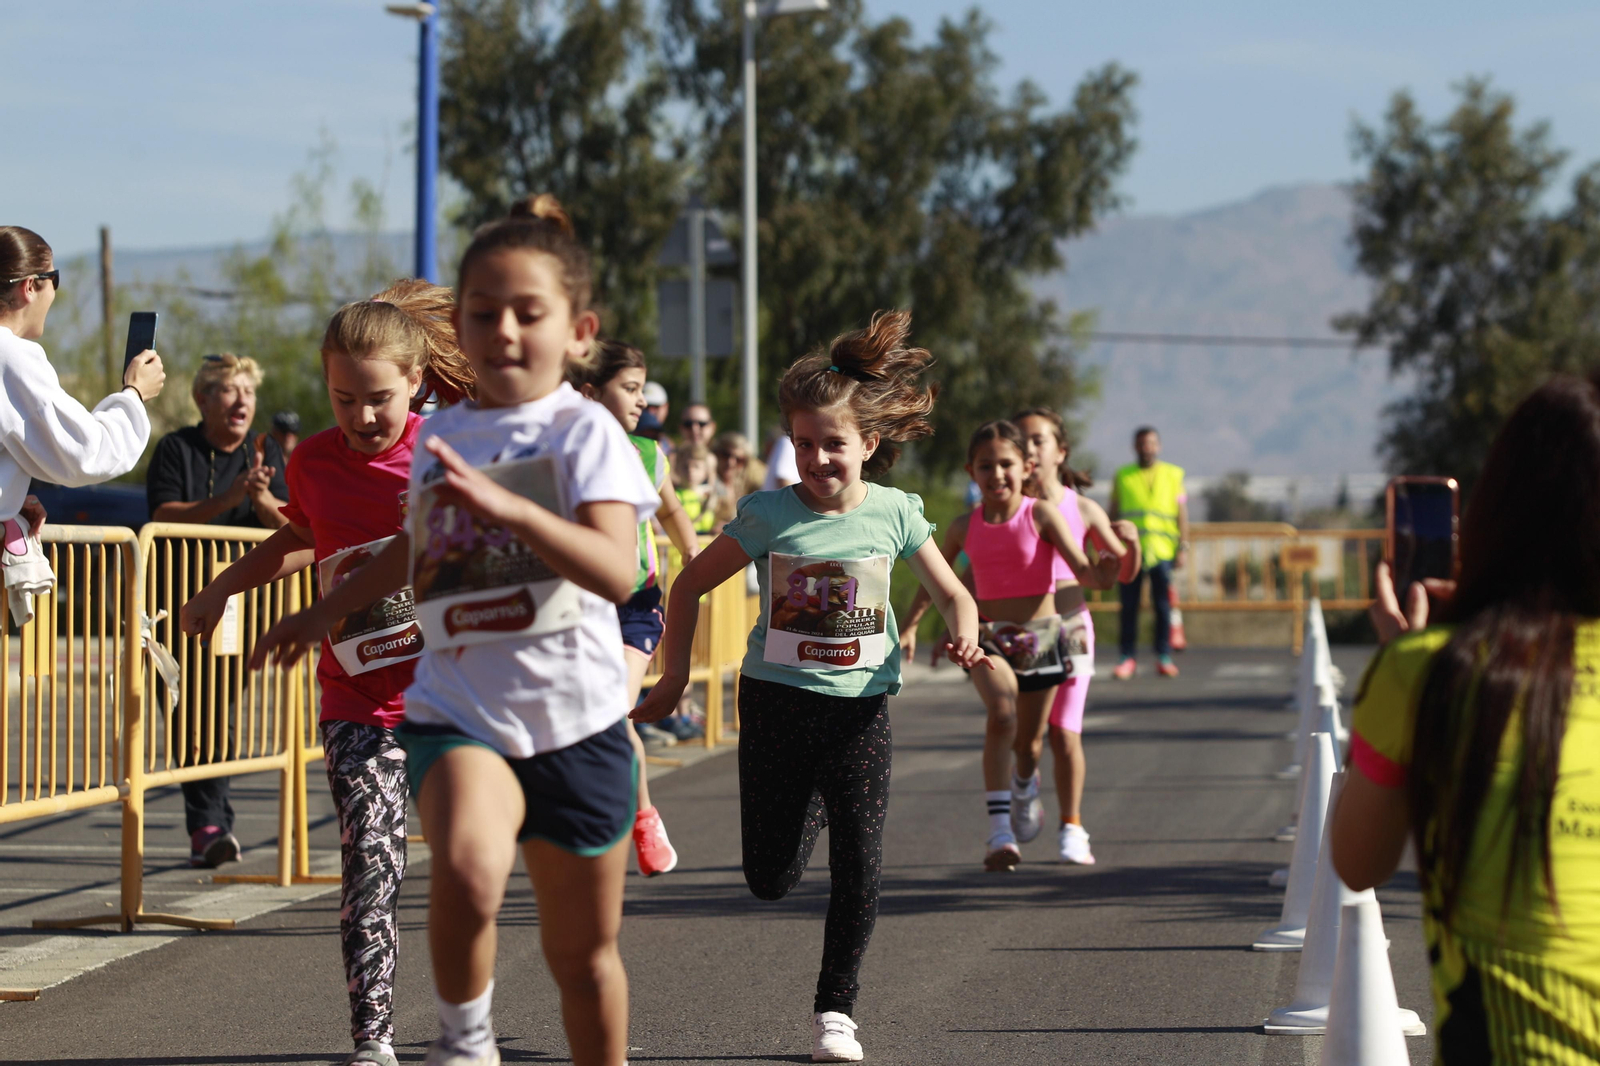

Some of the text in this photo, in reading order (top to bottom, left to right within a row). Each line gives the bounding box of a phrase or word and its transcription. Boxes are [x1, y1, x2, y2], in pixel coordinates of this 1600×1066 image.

[787, 573, 858, 612] 811
[837, 607, 876, 619] XIII
[387, 619, 402, 627] DEL
[836, 616, 876, 624] CARRERA
[836, 621, 876, 629] POPULAR
[804, 646, 856, 659] Caparrós
